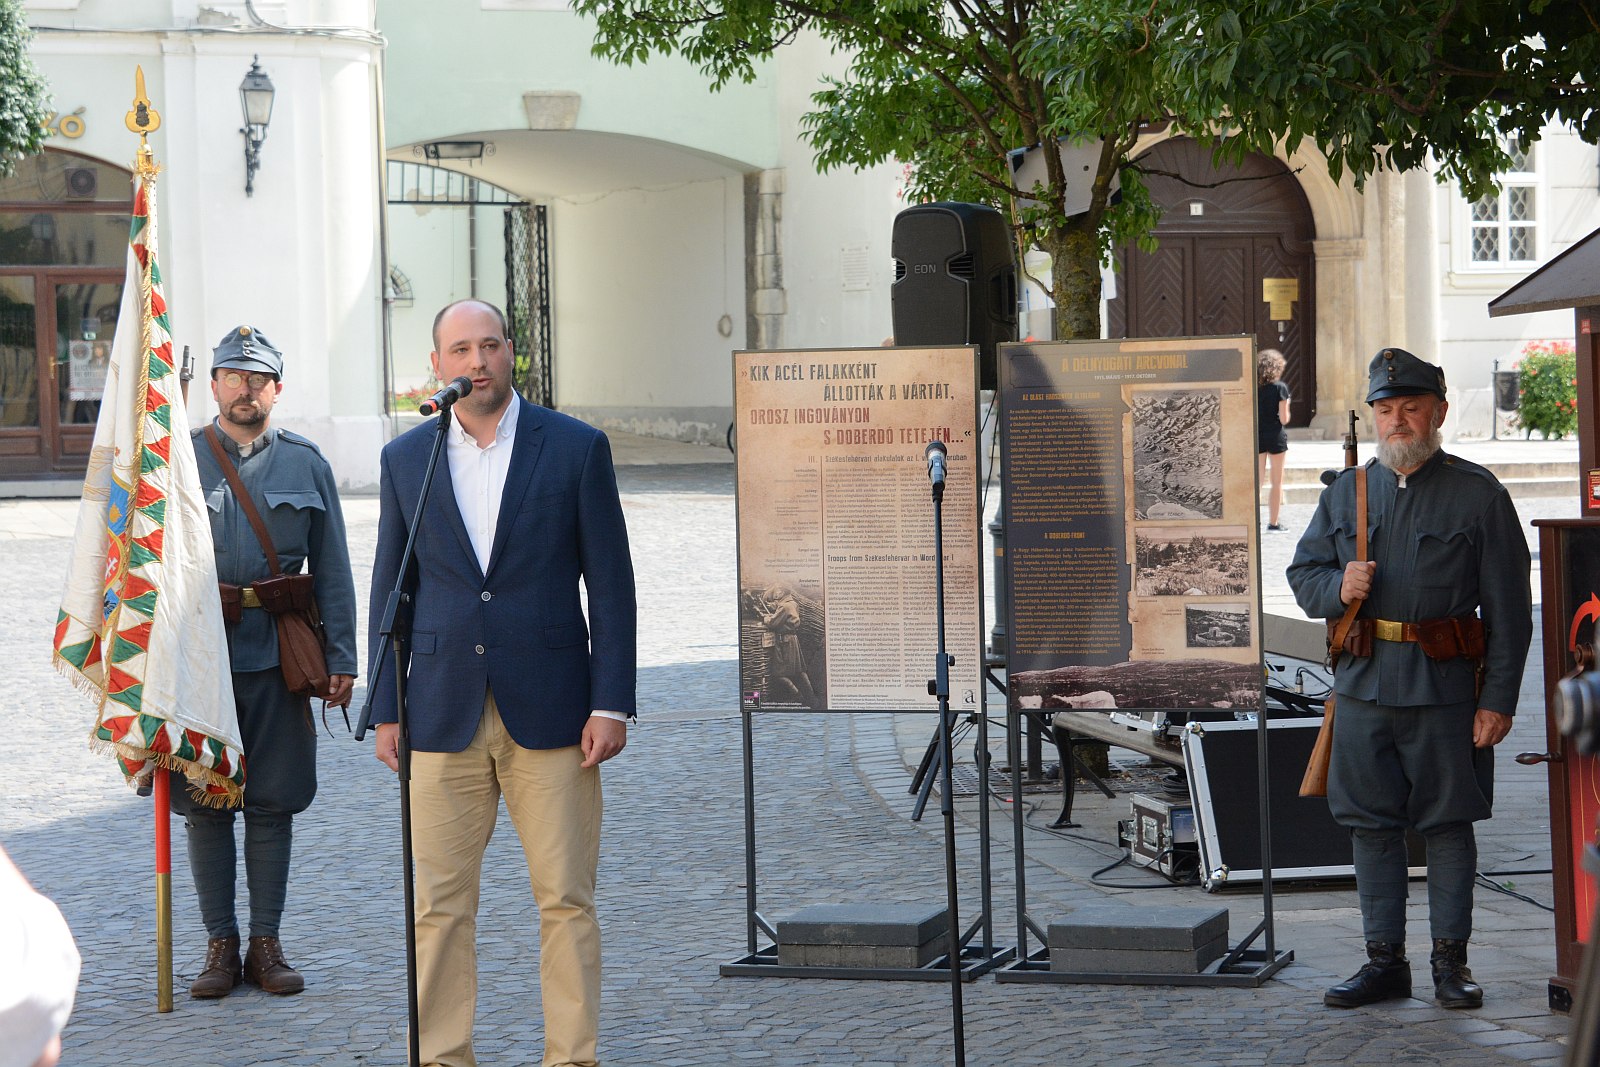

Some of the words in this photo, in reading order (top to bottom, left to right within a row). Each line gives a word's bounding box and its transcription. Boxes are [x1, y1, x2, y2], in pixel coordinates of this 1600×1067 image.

[914, 264, 936, 274] EON
[774, 362, 804, 381] ACÉL
[810, 362, 878, 380] FALAKKÉNT
[1061, 358, 1070, 373] A
[1136, 353, 1188, 370] ARCVONAL
[824, 382, 884, 402] ÁLLOTTÁK
[889, 384, 898, 400] A
[902, 382, 954, 400] VÁRTÁT,
[750, 408, 789, 425] OROSZ
[794, 406, 870, 424] INGOVÁNYON
[836, 426, 894, 445] DOBERDÓ
[828, 554, 847, 562] Troops
[849, 554, 863, 562] from
